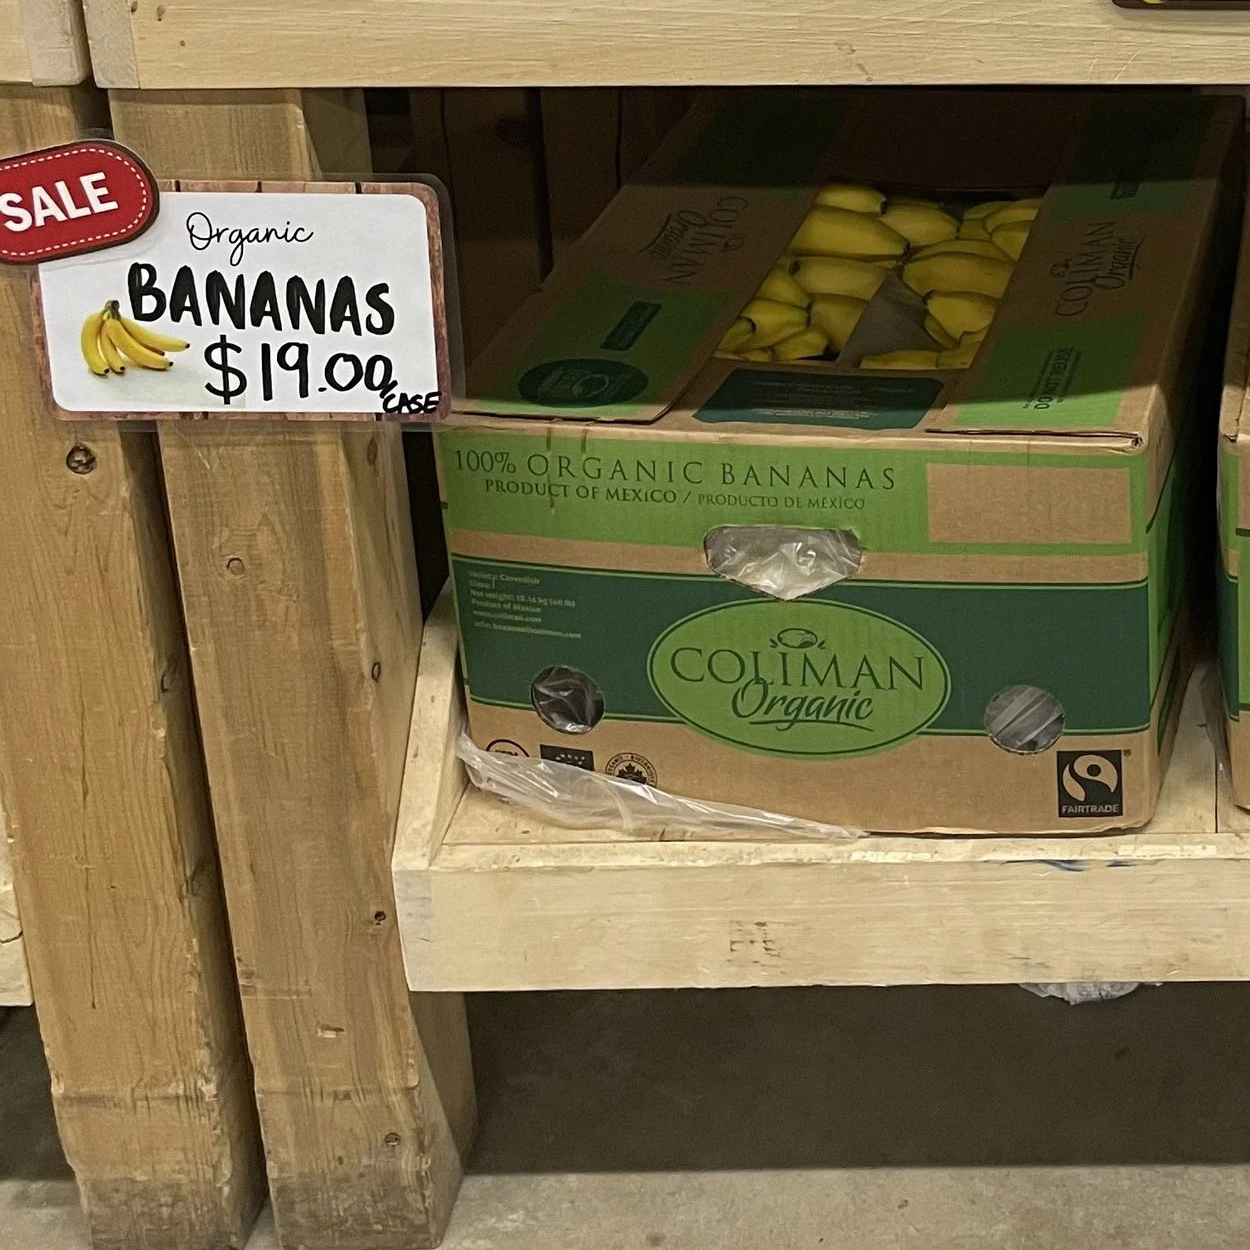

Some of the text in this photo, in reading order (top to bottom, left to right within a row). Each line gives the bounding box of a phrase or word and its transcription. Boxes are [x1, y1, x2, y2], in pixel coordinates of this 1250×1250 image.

[0, 172, 118, 232] SALE
[186, 211, 313, 266] Organic
[663, 196, 748, 285] COLIMAN
[1055, 221, 1116, 317] COLIMAN
[128, 262, 395, 336] BANANAS
[453, 449, 896, 491] 100% ORGANIC BANANAS
[485, 479, 569, 499] PRODUCT
[575, 484, 599, 500] OF
[604, 486, 677, 504] MEXICO
[698, 493, 778, 508] PRODUCTO
[783, 496, 803, 509] DE
[670, 647, 924, 691] COLIMAN
[731, 677, 874, 731] Organic
[1061, 804, 1119, 814] FAIRTRADE
